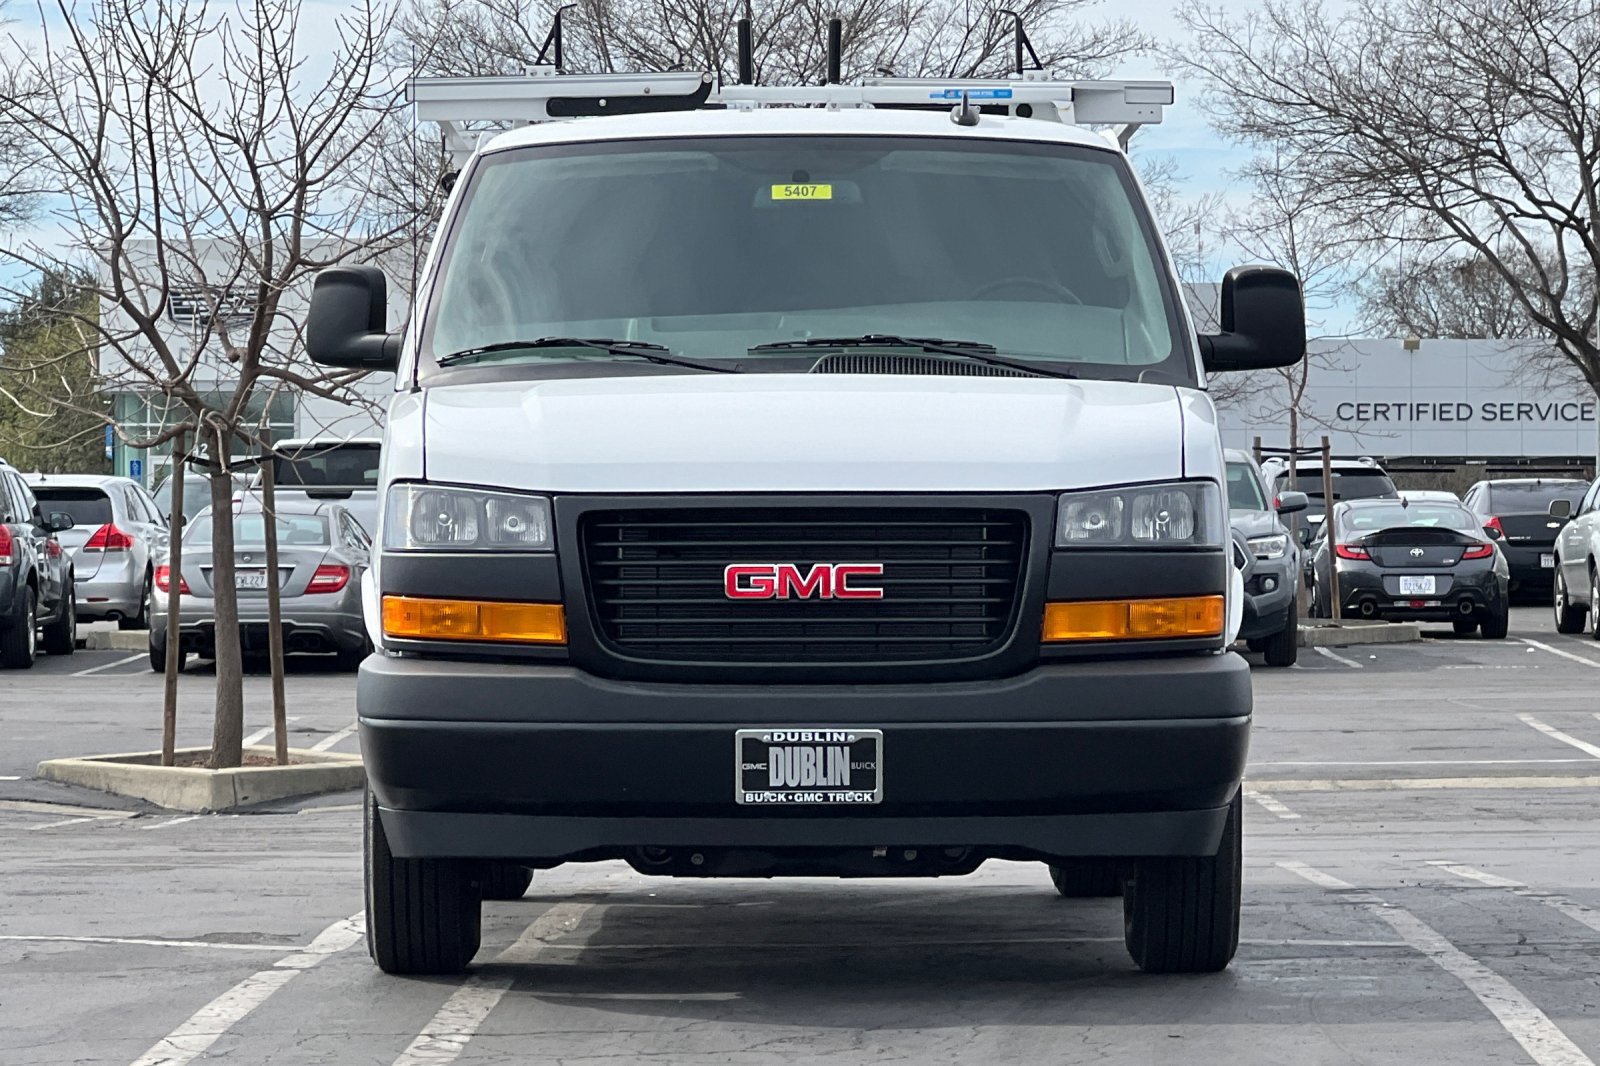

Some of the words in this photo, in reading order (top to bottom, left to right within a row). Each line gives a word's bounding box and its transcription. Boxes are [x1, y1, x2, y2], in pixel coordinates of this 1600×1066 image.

[784, 186, 817, 197] 5407
[1336, 402, 1473, 421] CERTIFIED
[1481, 402, 1596, 421] SERVICE
[724, 563, 883, 599] GMC
[773, 732, 846, 742] DUBLIN
[768, 746, 850, 787] DUBLIN
[851, 762, 876, 770] BUICK
[828, 792, 872, 802] TRUCK
